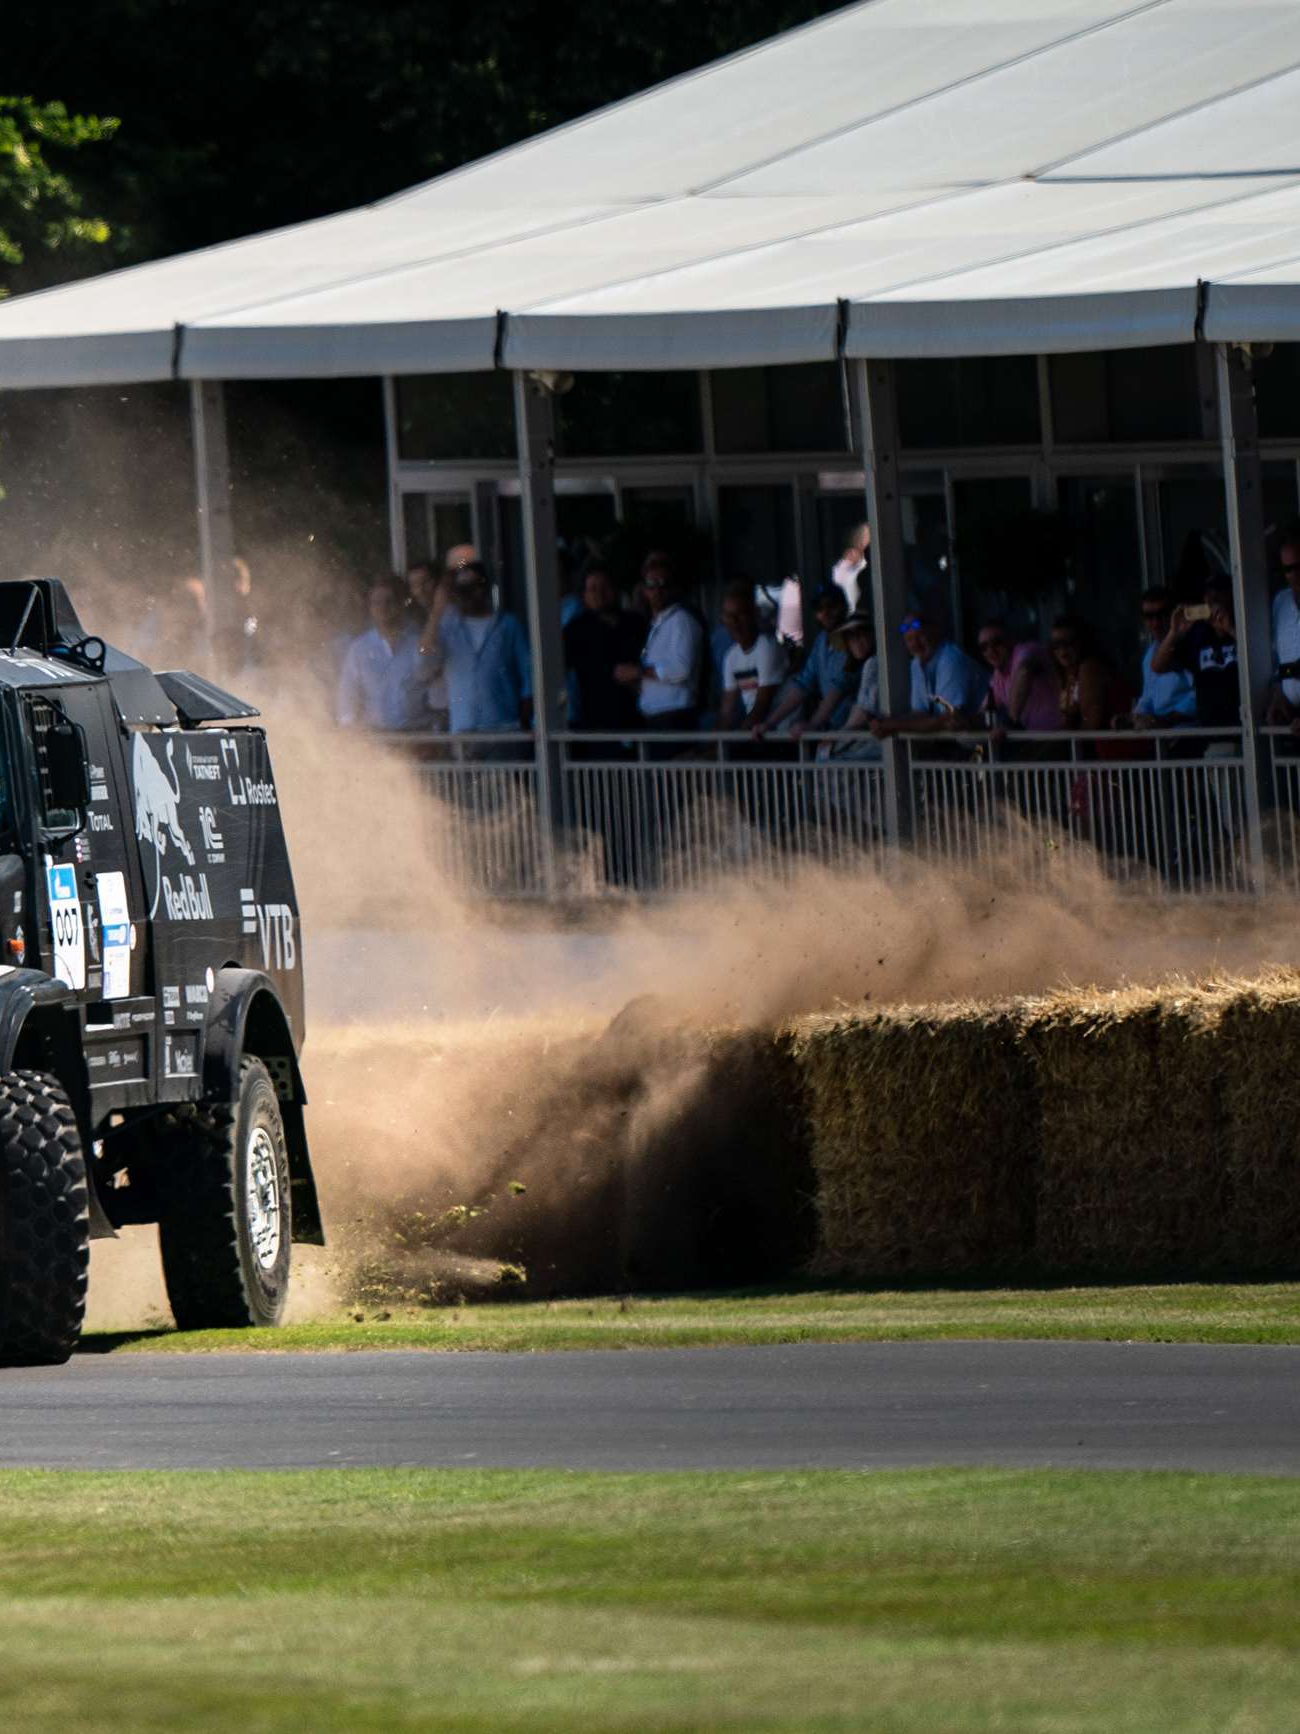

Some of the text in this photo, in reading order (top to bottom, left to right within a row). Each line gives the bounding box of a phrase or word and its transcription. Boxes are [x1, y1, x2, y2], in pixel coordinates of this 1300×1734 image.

[245, 777, 276, 805] Rostec
[56, 908, 78, 946] 007
[257, 904, 295, 970] VTB
